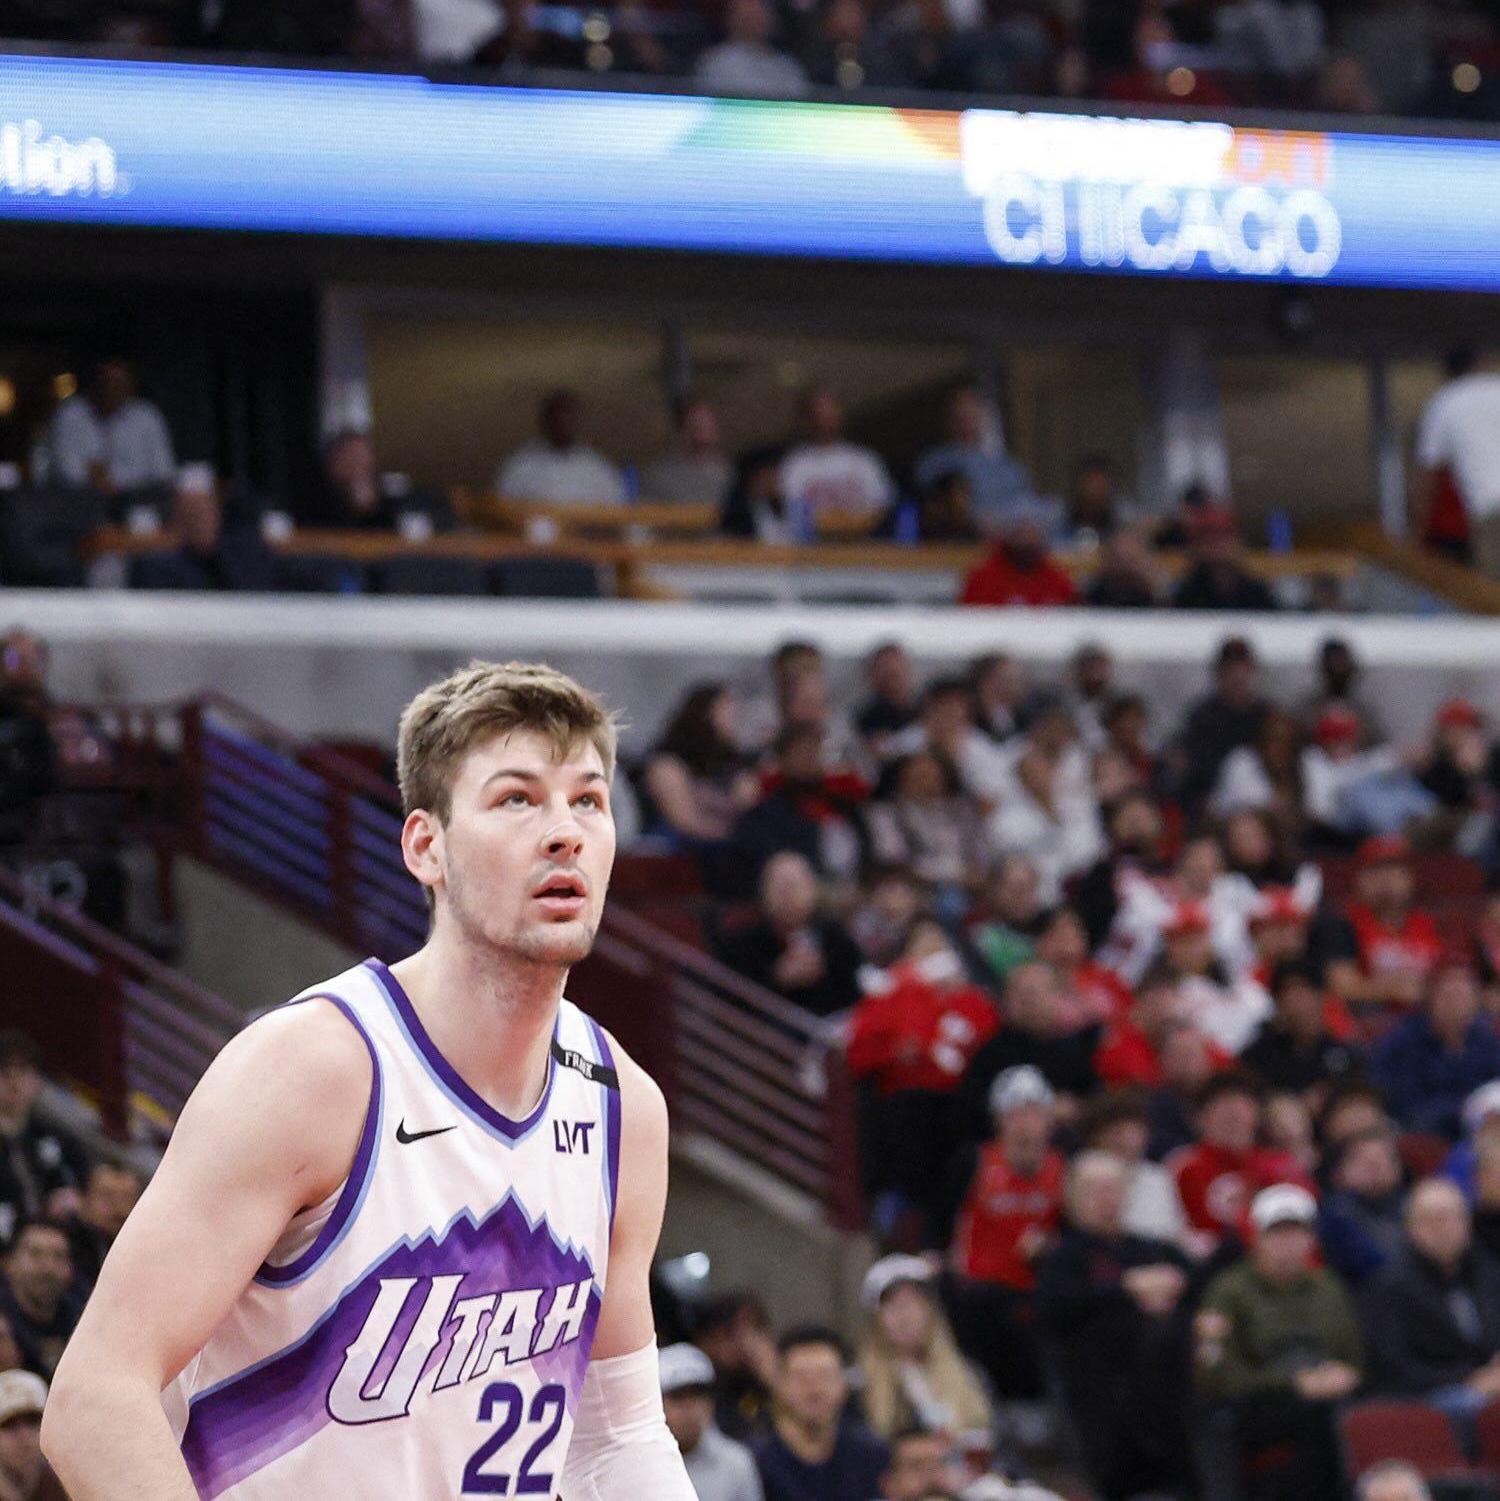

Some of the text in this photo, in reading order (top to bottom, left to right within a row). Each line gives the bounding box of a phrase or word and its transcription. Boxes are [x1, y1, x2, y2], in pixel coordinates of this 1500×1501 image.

[984, 174, 1341, 278] CHICAGO
[553, 1118, 596, 1155] LVT
[325, 1272, 595, 1426] UTAH
[460, 1380, 567, 1497] 22
